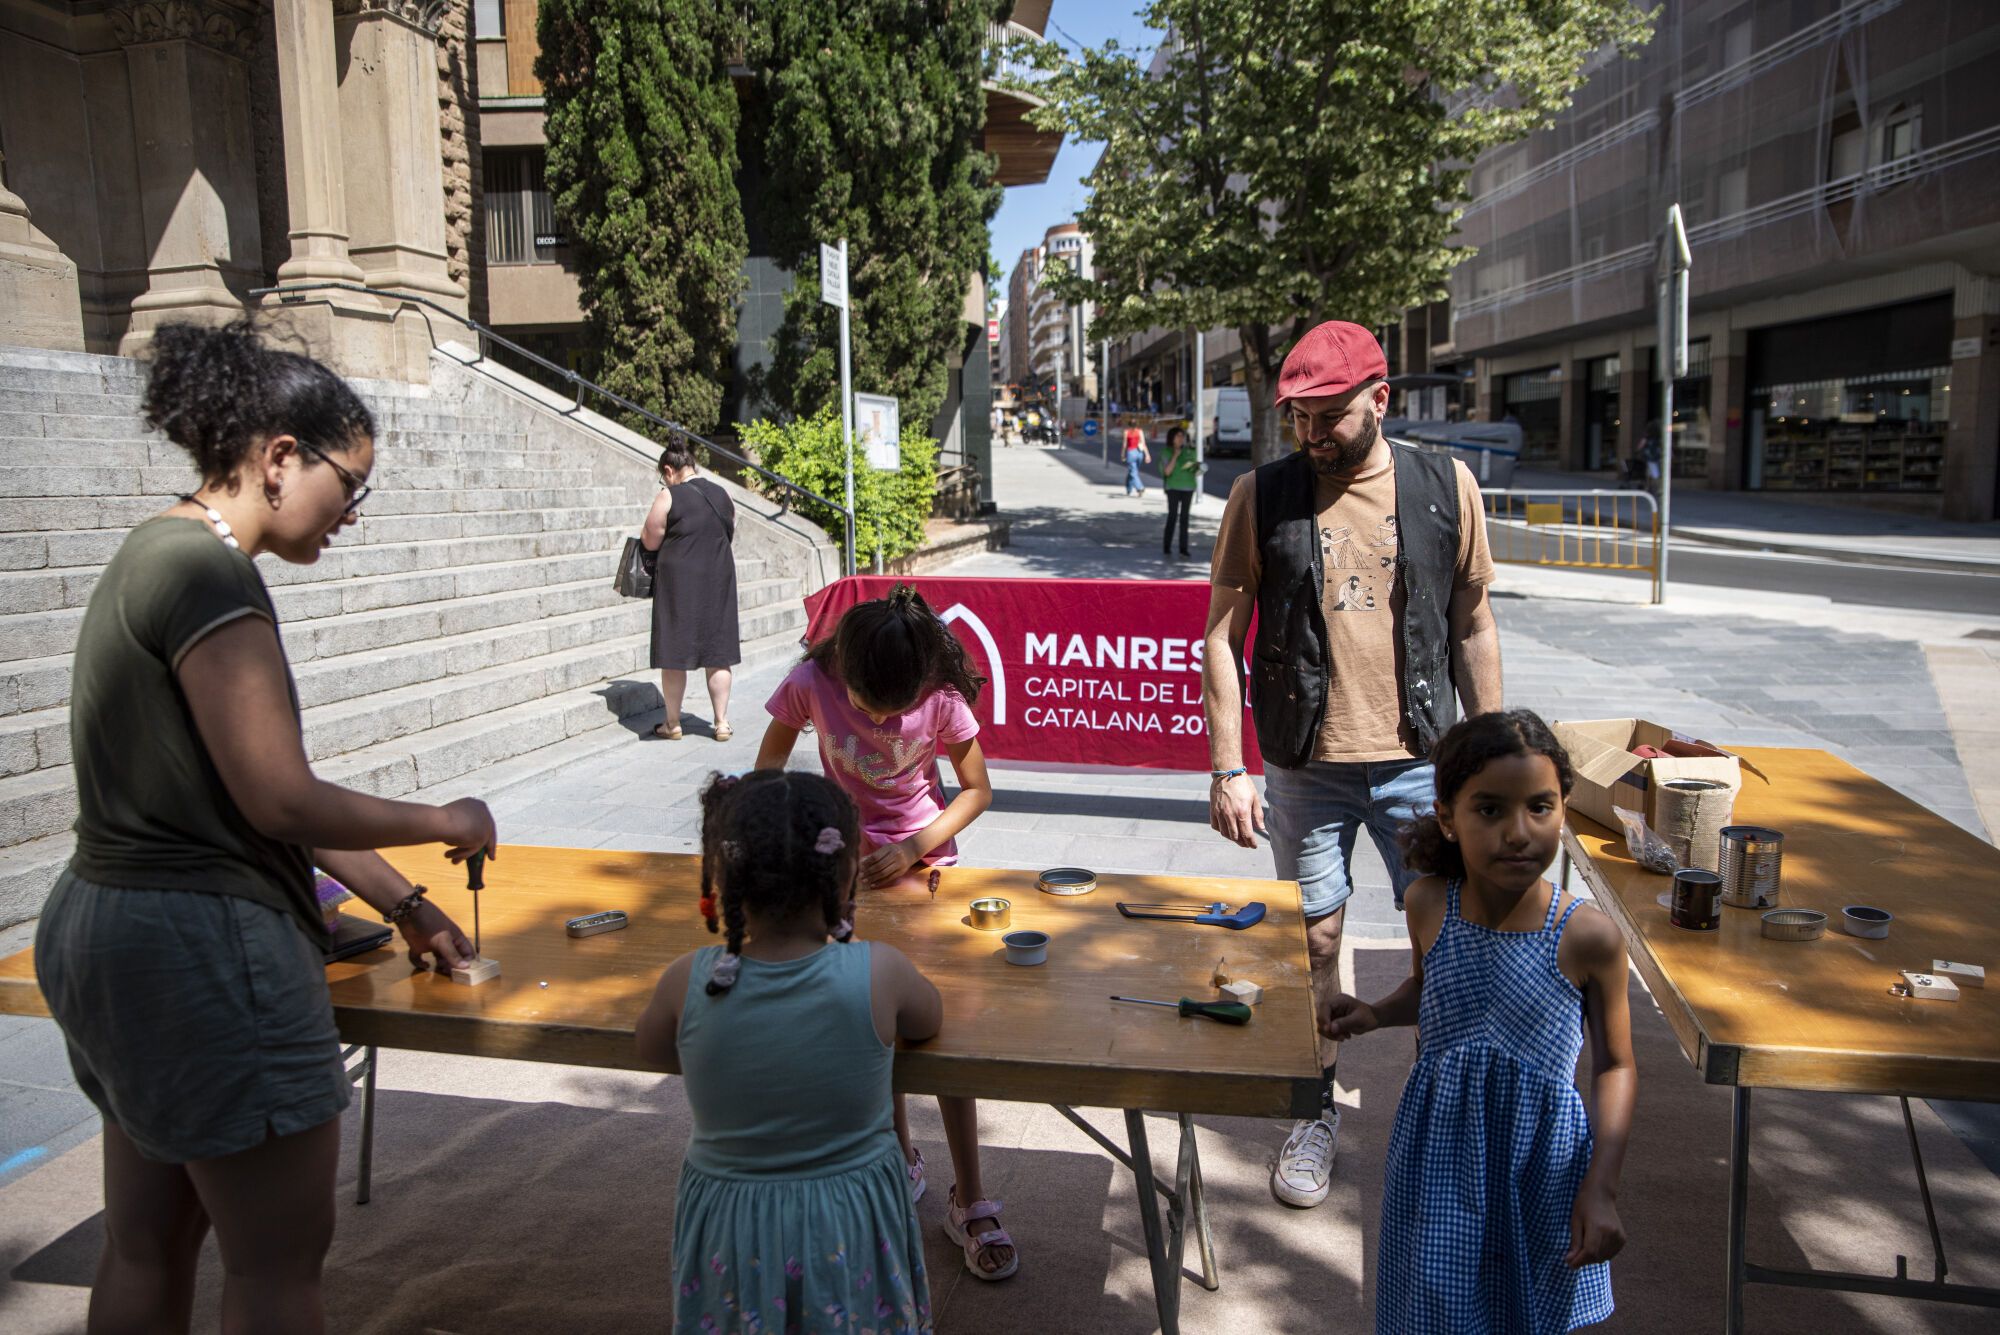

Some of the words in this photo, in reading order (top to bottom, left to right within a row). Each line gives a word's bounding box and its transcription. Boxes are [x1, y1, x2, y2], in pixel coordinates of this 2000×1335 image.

[1024, 632, 1250, 674] MANRES
[1024, 677, 1131, 701] CAPITAL
[1140, 682, 1174, 704] DE
[1182, 684, 1205, 705] L
[1024, 706, 1163, 734] CATALANA
